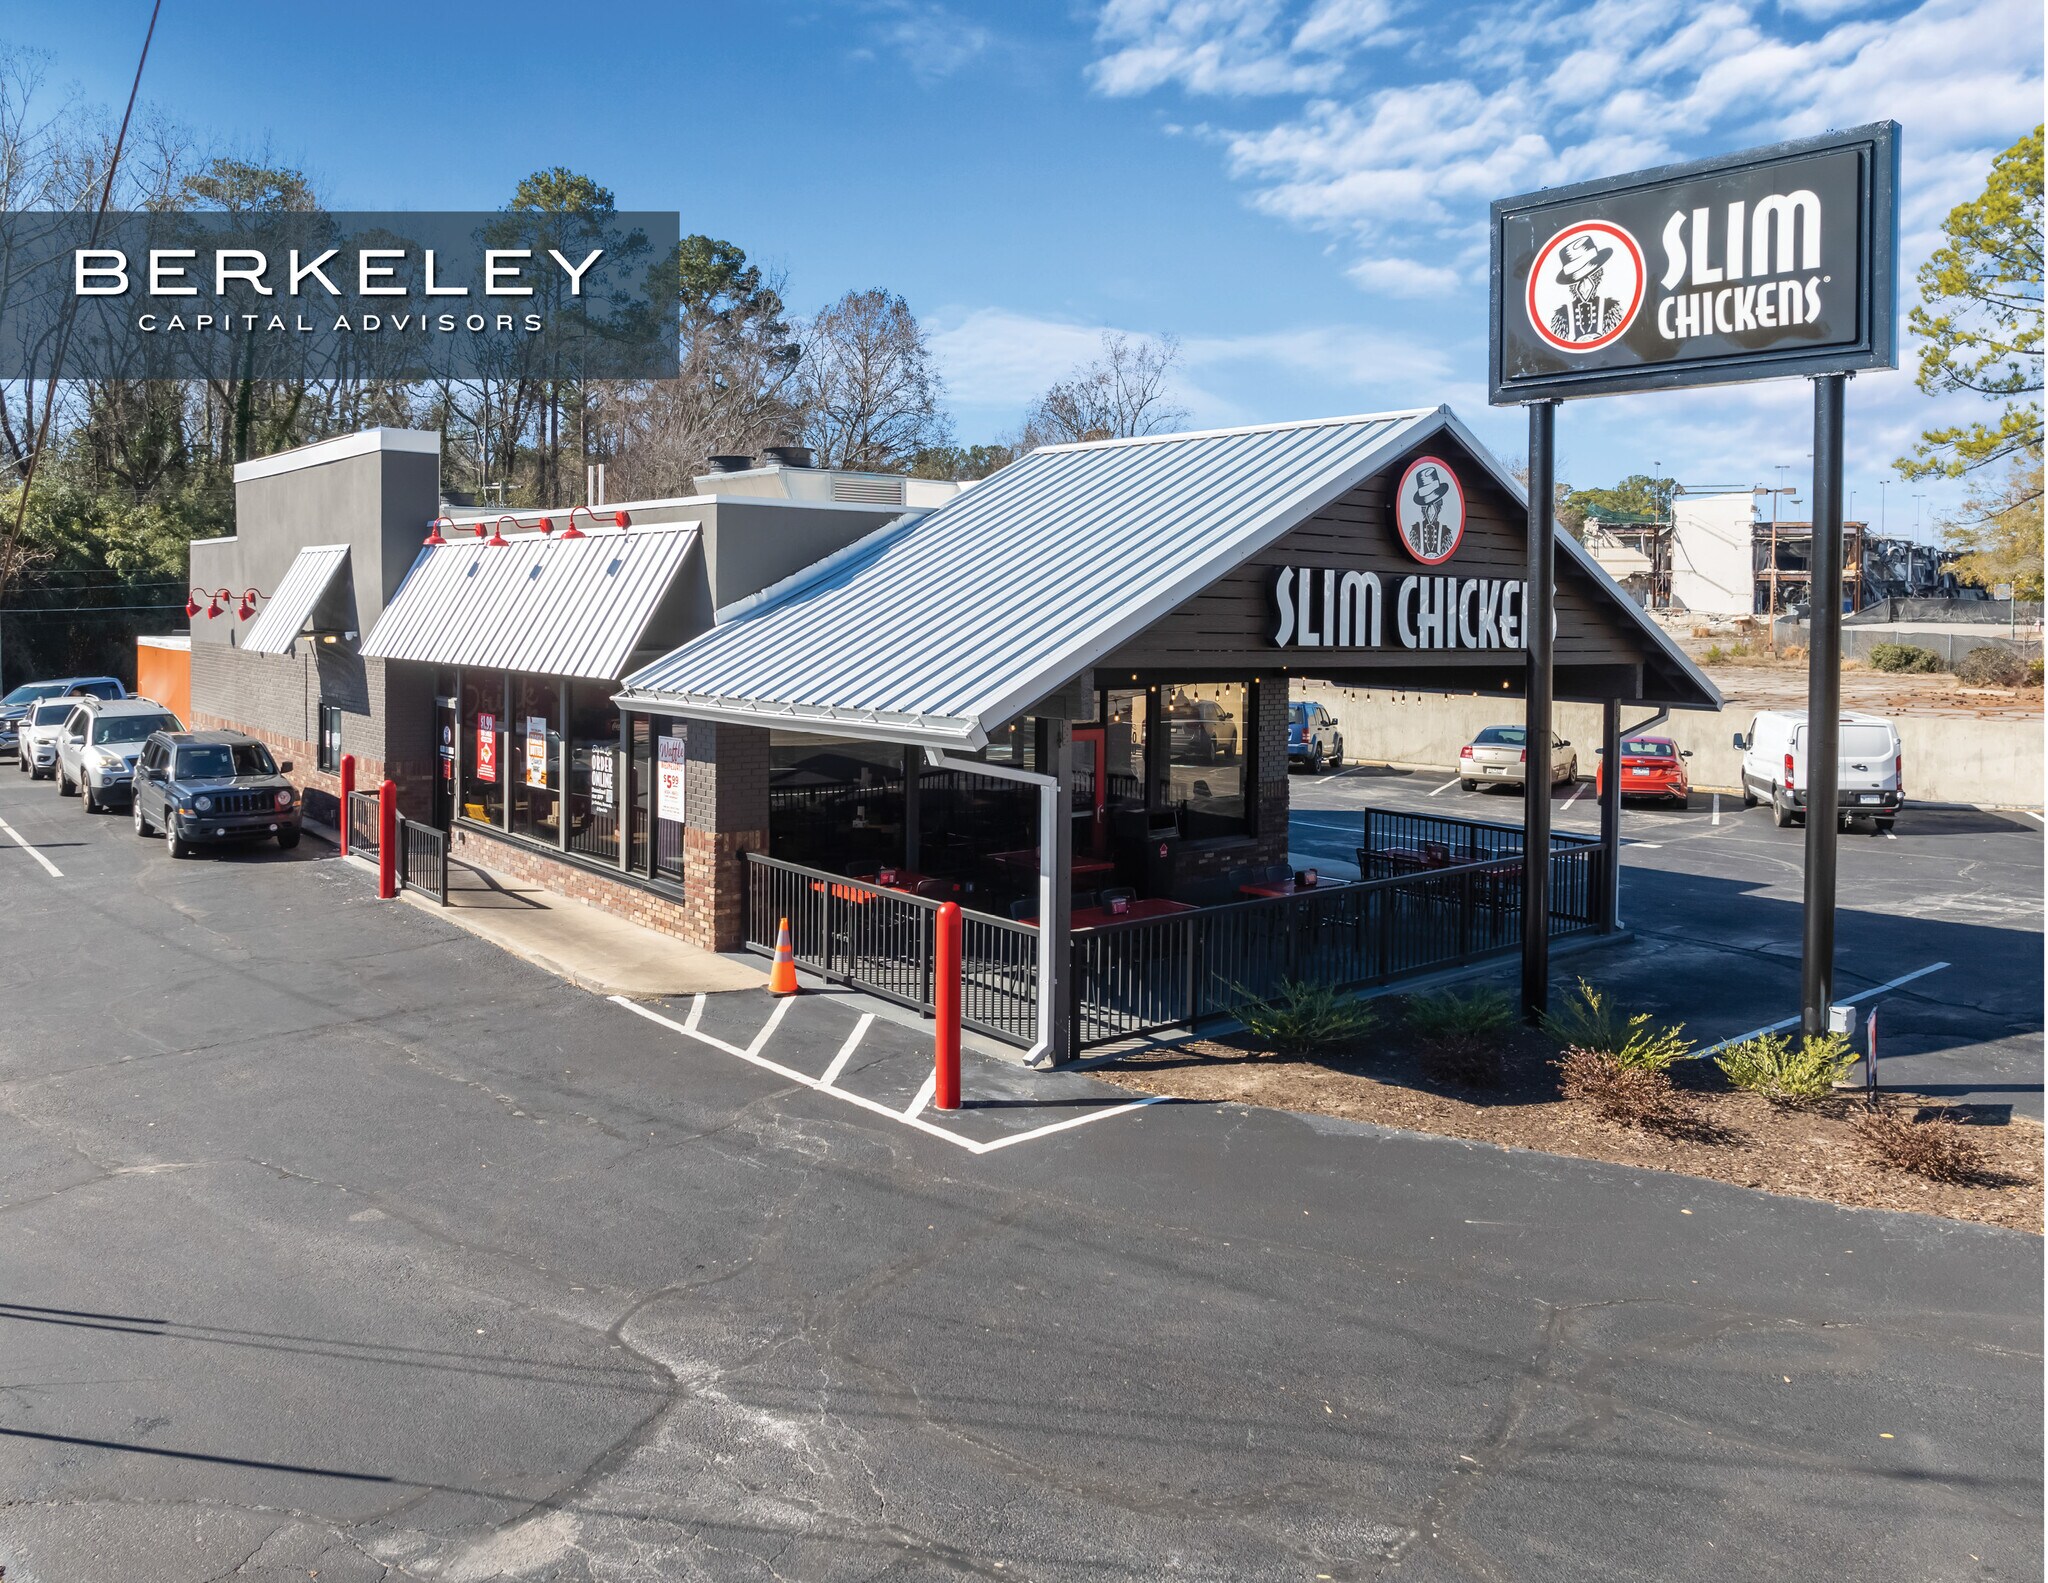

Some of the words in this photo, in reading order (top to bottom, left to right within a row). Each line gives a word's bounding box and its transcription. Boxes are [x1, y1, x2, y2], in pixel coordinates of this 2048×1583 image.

[1660, 189, 1822, 291] SLIM
[1275, 565, 1382, 648] SLIM
[1396, 575, 1558, 649] CHICKE
[659, 741, 684, 763] Waffle
[591, 754, 613, 774] ORDER
[591, 770, 613, 789] ONLINE
